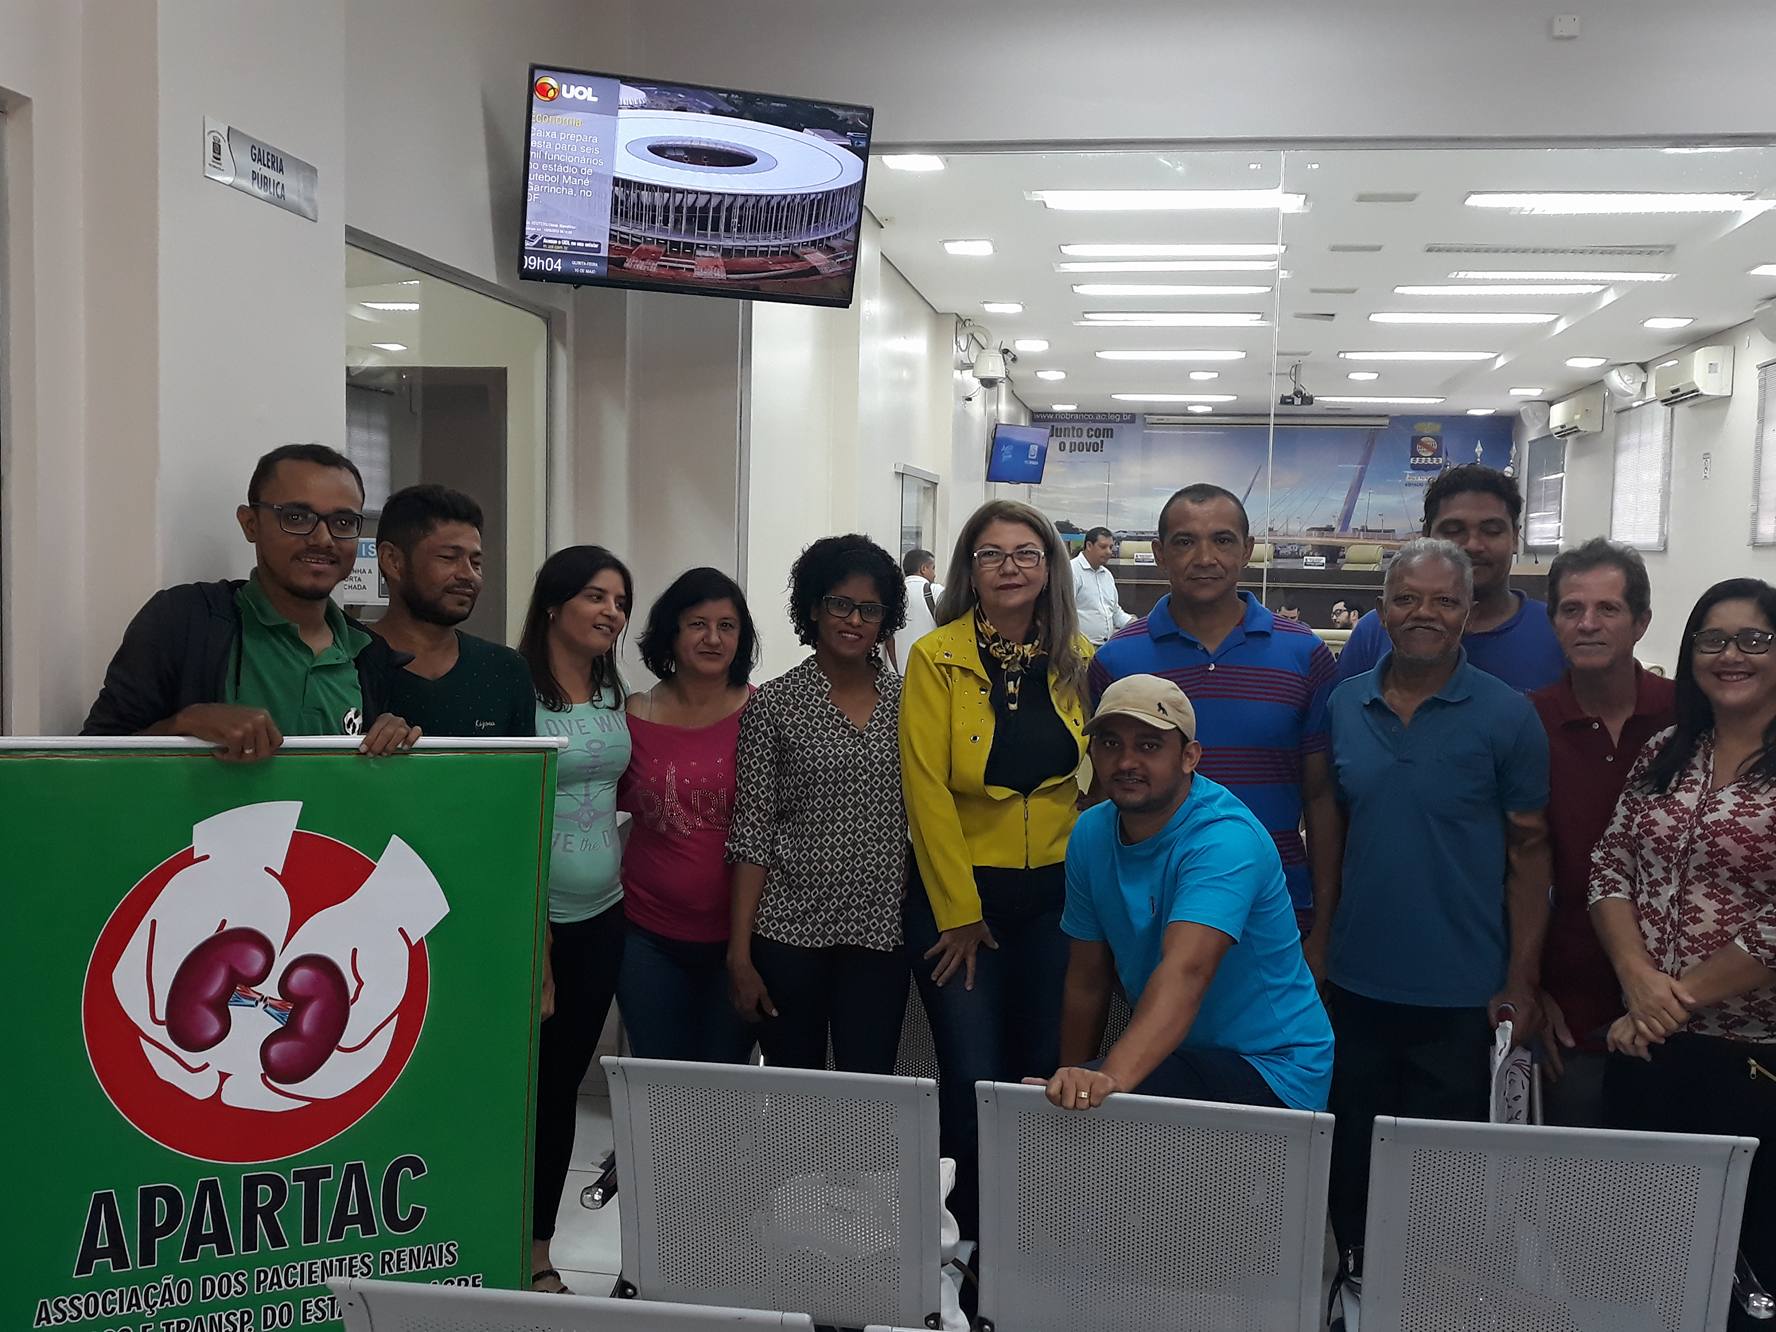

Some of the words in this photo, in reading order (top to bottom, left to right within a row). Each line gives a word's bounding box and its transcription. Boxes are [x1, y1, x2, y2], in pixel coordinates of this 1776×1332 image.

[562, 84, 598, 102] UOL
[559, 132, 598, 143] prepara
[531, 140, 552, 149] esta
[555, 143, 577, 153] para
[580, 145, 600, 155] seis
[250, 144, 284, 175] GALERIA
[544, 150, 604, 167] funcionários
[542, 161, 578, 175] estádio
[580, 166, 593, 176] de
[251, 167, 286, 201] PÚBLICA
[528, 171, 560, 183] utebol
[562, 174, 590, 187] Mané
[579, 189, 593, 198] no
[1049, 425, 1084, 439] Junto
[1086, 427, 1114, 439] com
[1058, 442, 1067, 452] o
[1069, 440, 1104, 453] povo!
[540, 717, 591, 738] OVE
[73, 1153, 428, 1278] APARTAC
[33, 1274, 192, 1328] ASSOCIAÇÃO
[199, 1269, 248, 1303] DOS
[254, 1252, 374, 1294] PACIENTES
[379, 1241, 459, 1276] RENAIS
[261, 1302, 293, 1331] DO
[301, 1296, 343, 1326] EST
